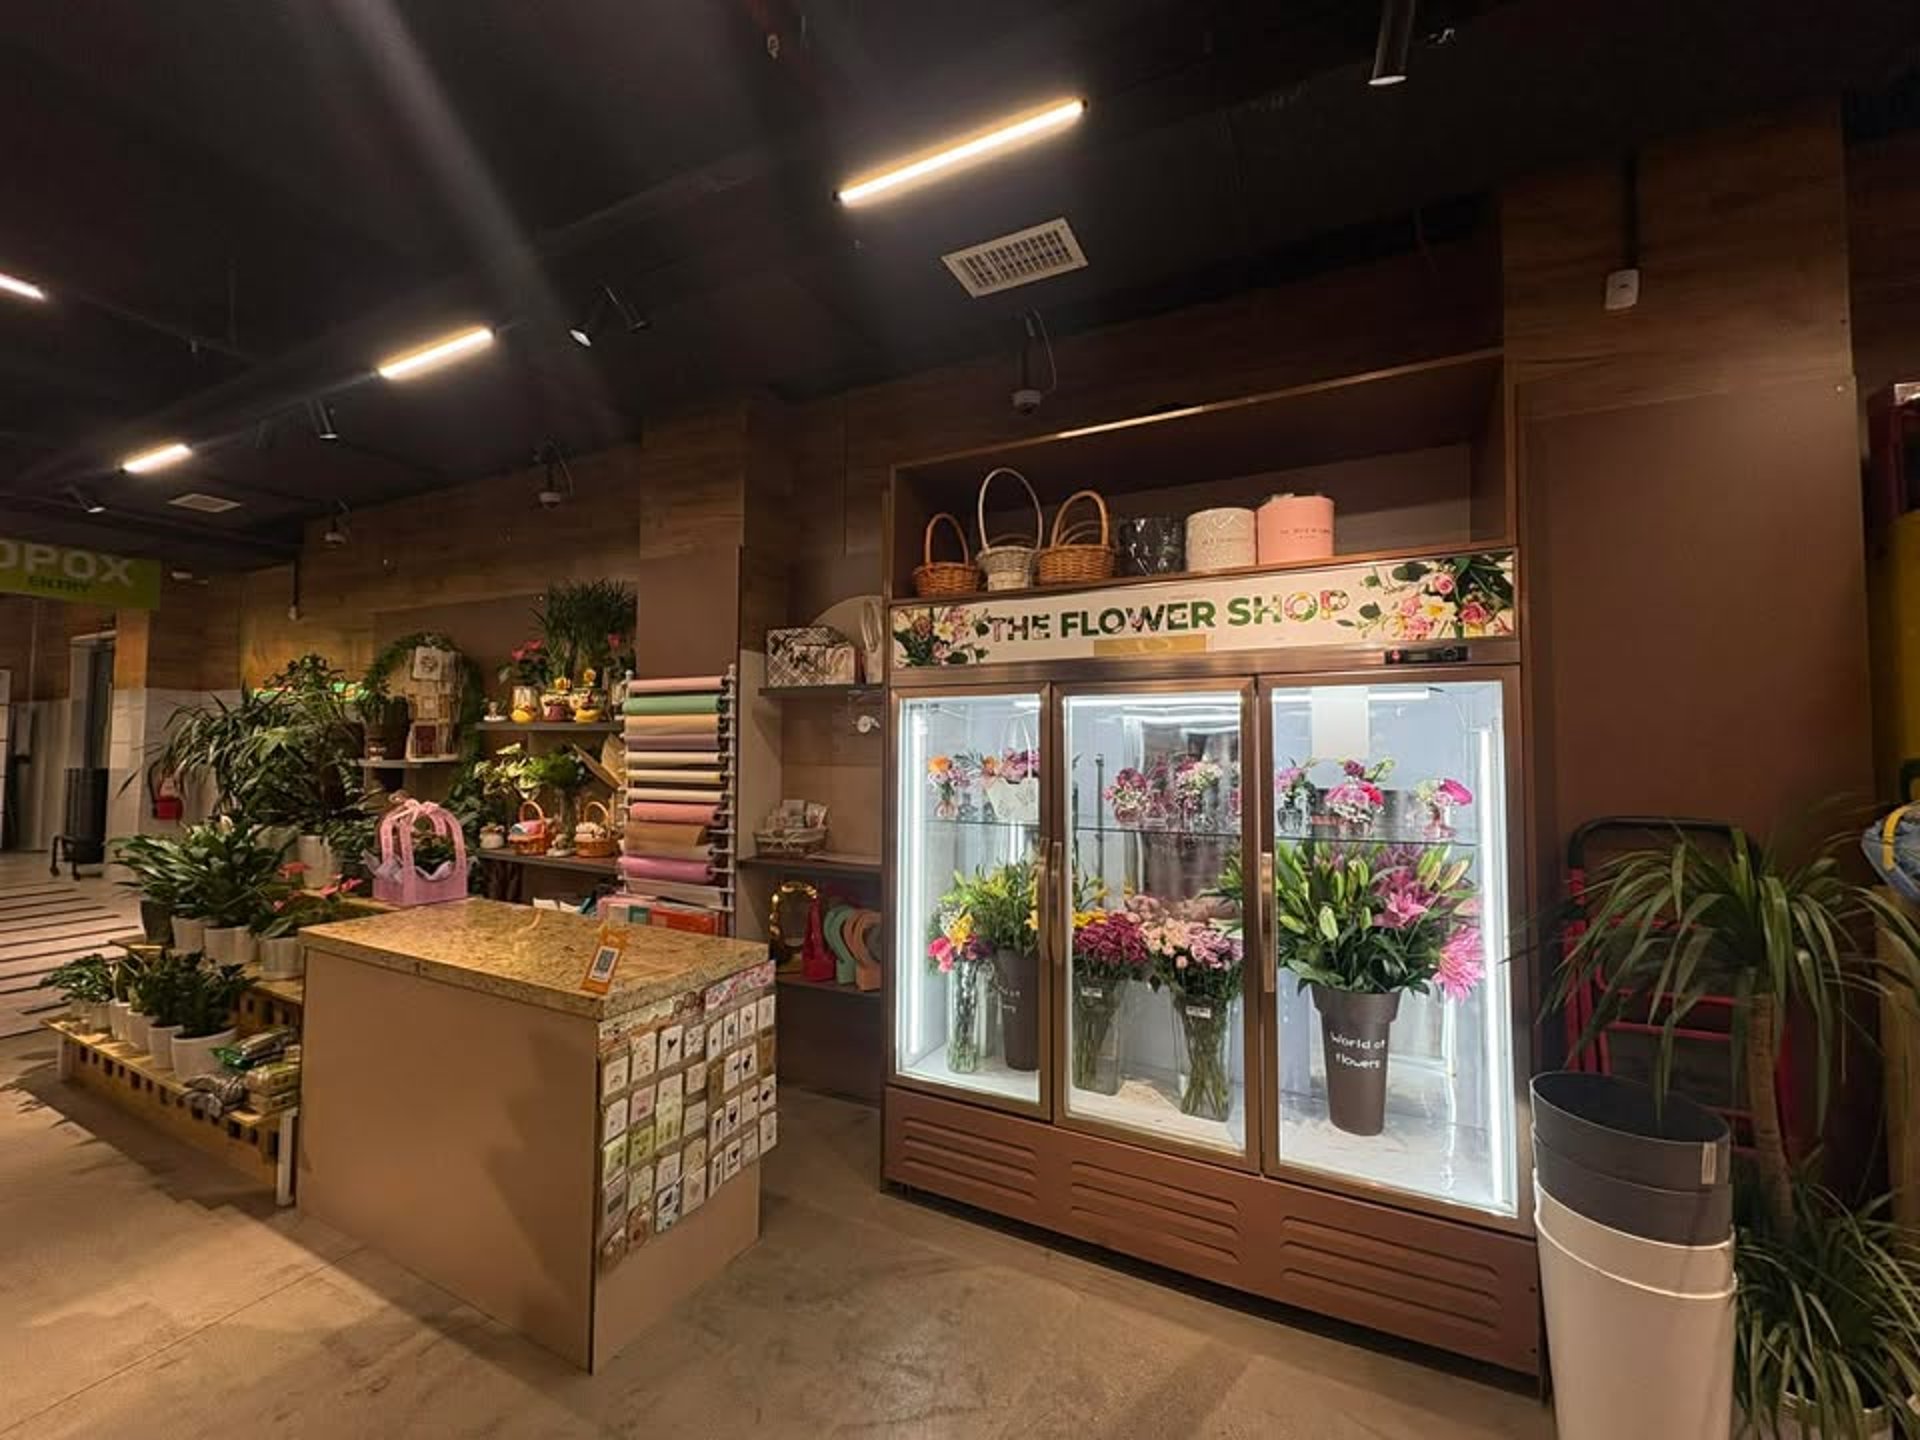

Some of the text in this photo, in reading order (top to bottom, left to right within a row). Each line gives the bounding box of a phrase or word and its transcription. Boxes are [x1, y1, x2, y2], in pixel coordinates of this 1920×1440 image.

[988, 590, 1350, 642] THE FLOWER SHOP
[1329, 1030, 1371, 1049] World
